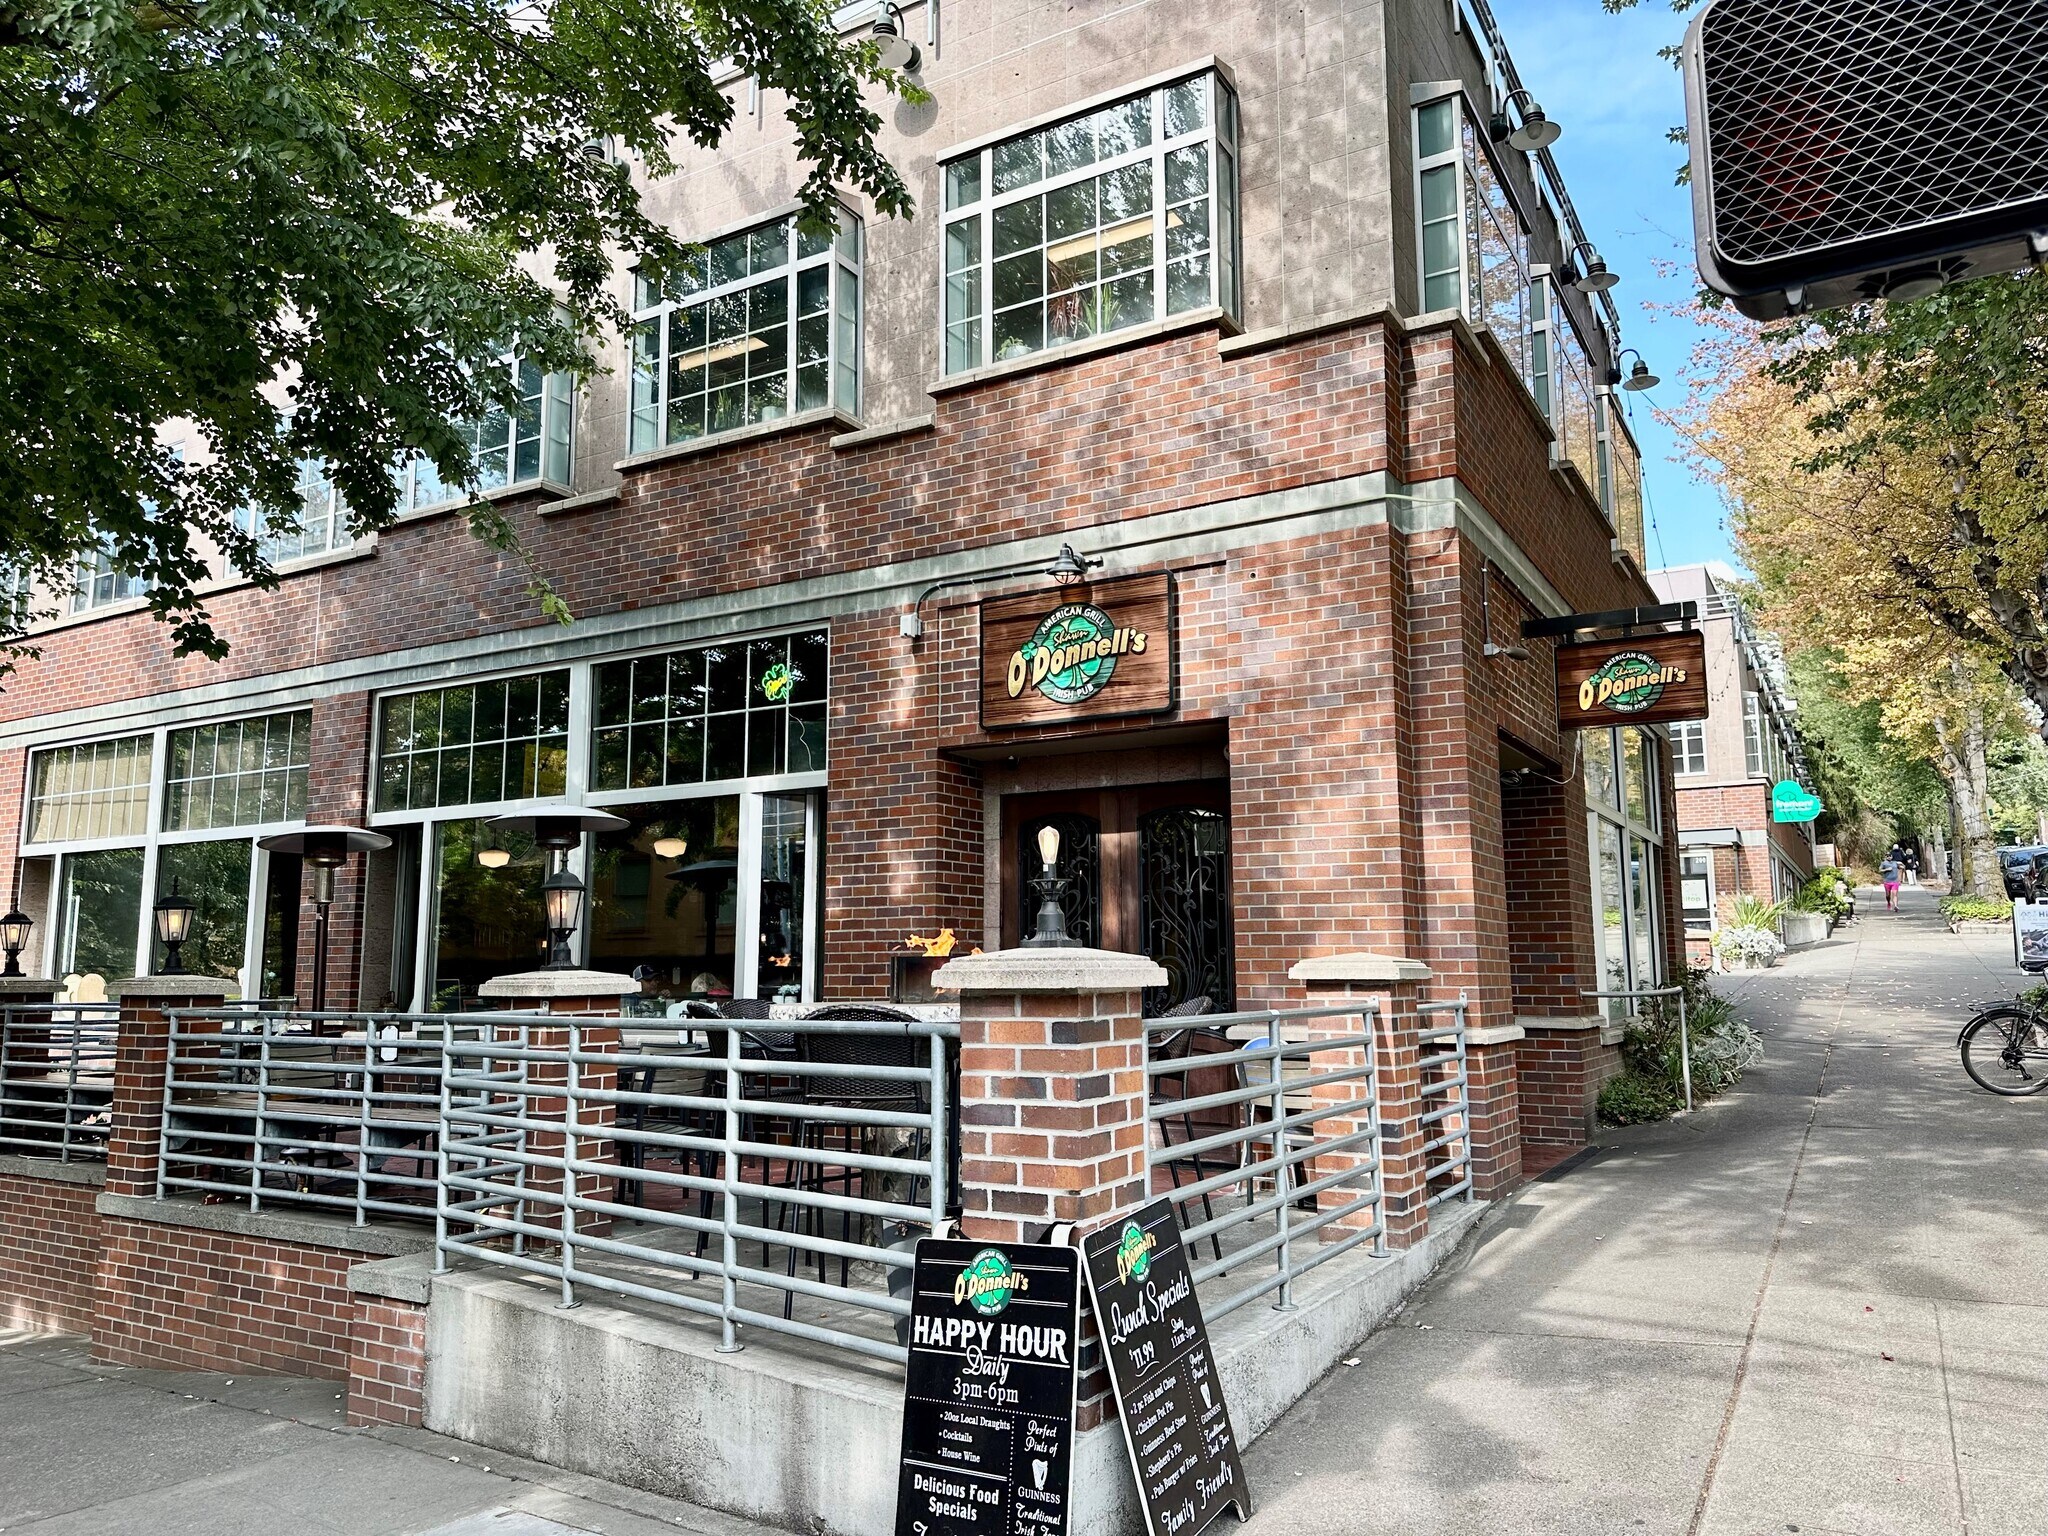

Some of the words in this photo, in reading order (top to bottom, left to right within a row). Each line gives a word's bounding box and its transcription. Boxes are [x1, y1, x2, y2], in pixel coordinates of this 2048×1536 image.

[1040, 606, 1082, 635] AMERICAN
[1084, 607, 1107, 628] GRILL
[1603, 652, 1637, 670] AMERICAN
[1637, 653, 1655, 667] GRILL
[1053, 686, 1075, 699] IRISH
[1076, 684, 1095, 699] PUB
[1615, 702, 1633, 712] IRISH
[1634, 701, 1649, 711] PUB
[972, 1250, 996, 1268] AMERICAN
[996, 1251, 1009, 1268] GRILL
[1111, 1290, 1150, 1346] Lunch
[1146, 1270, 1190, 1323] Specials
[913, 1314, 995, 1351] HAPPY
[1000, 1322, 1070, 1364] HOUR
[962, 1344, 1010, 1385] Daily
[1129, 1340, 1156, 1370] $11.99
[952, 1377, 1020, 1406] 3pm-6pm
[1132, 1402, 1138, 1414] 2
[1137, 1400, 1144, 1414] pc
[1142, 1390, 1155, 1407] Fish
[1154, 1382, 1164, 1398] and
[1162, 1376, 1177, 1391] Chips
[943, 1411, 960, 1423] 20oz
[960, 1413, 979, 1426] Local
[979, 1416, 1011, 1432] Draughts
[1026, 1419, 1058, 1439] Perfect
[1137, 1416, 1158, 1435] Chicken
[1156, 1406, 1167, 1420] Pot
[1164, 1400, 1175, 1414] Pie
[942, 1429, 973, 1443] Cocktails
[1024, 1436, 1048, 1454] Pints
[1048, 1442, 1059, 1458] of
[1143, 1432, 1166, 1456] Guinness
[1163, 1420, 1176, 1439] Beef
[1174, 1414, 1187, 1430] Stew
[941, 1447, 963, 1460] House
[963, 1450, 981, 1463] Wine
[1148, 1449, 1175, 1477] Shepherd's
[1173, 1442, 1183, 1456] Pie
[913, 1473, 966, 1499] Delicious
[969, 1483, 1000, 1505] Food
[1153, 1482, 1165, 1499] Pub
[1163, 1469, 1180, 1490] Burger
[1185, 1454, 1199, 1470] Fries
[928, 1496, 978, 1521] Specials
[1017, 1486, 1061, 1505] GUINNESS
[1161, 1497, 1196, 1536] Family
[1195, 1460, 1233, 1510] Friendly
[1015, 1502, 1062, 1526] Traditional
